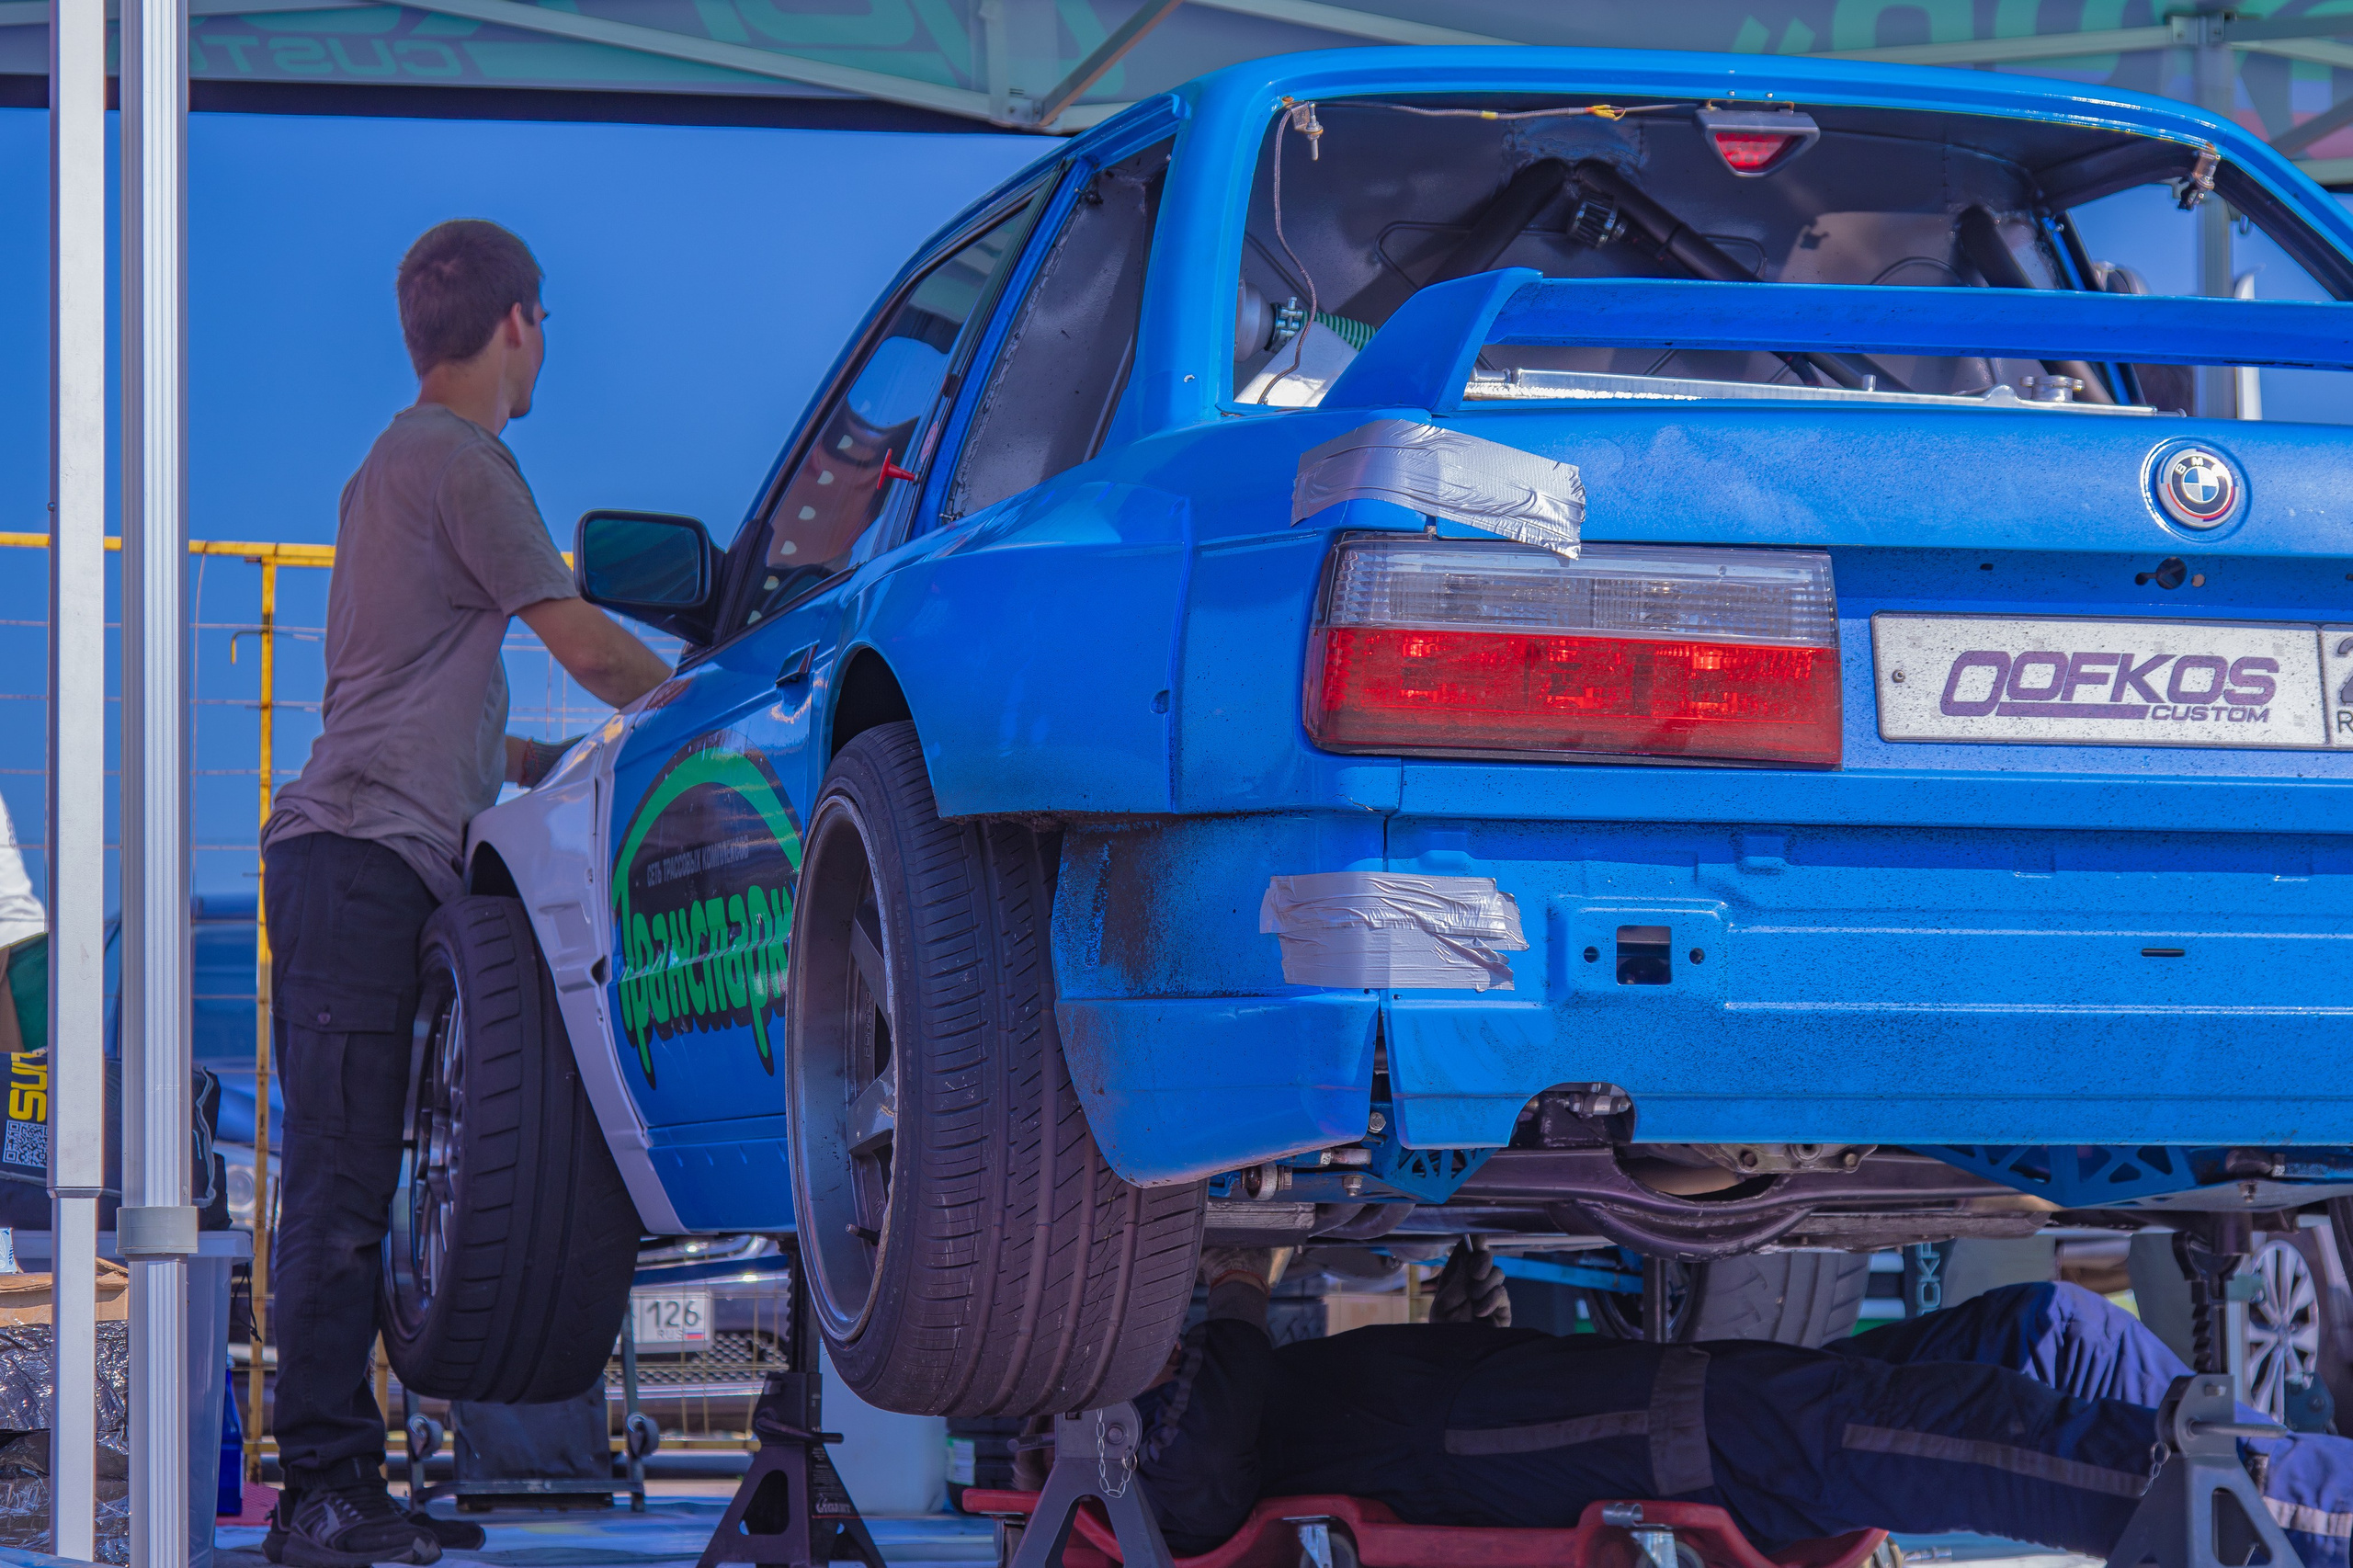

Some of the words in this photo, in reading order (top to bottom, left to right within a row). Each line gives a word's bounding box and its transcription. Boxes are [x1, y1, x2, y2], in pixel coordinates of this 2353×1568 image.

[2151, 704, 2272, 723] CUSTOM
[646, 860, 662, 887] СЕТЬ
[663, 848, 701, 882] ТРАССОВЫХ
[701, 834, 749, 871] КОМПЛЕКСОВ
[646, 1300, 701, 1327] 126
[657, 1330, 683, 1340] RUS
